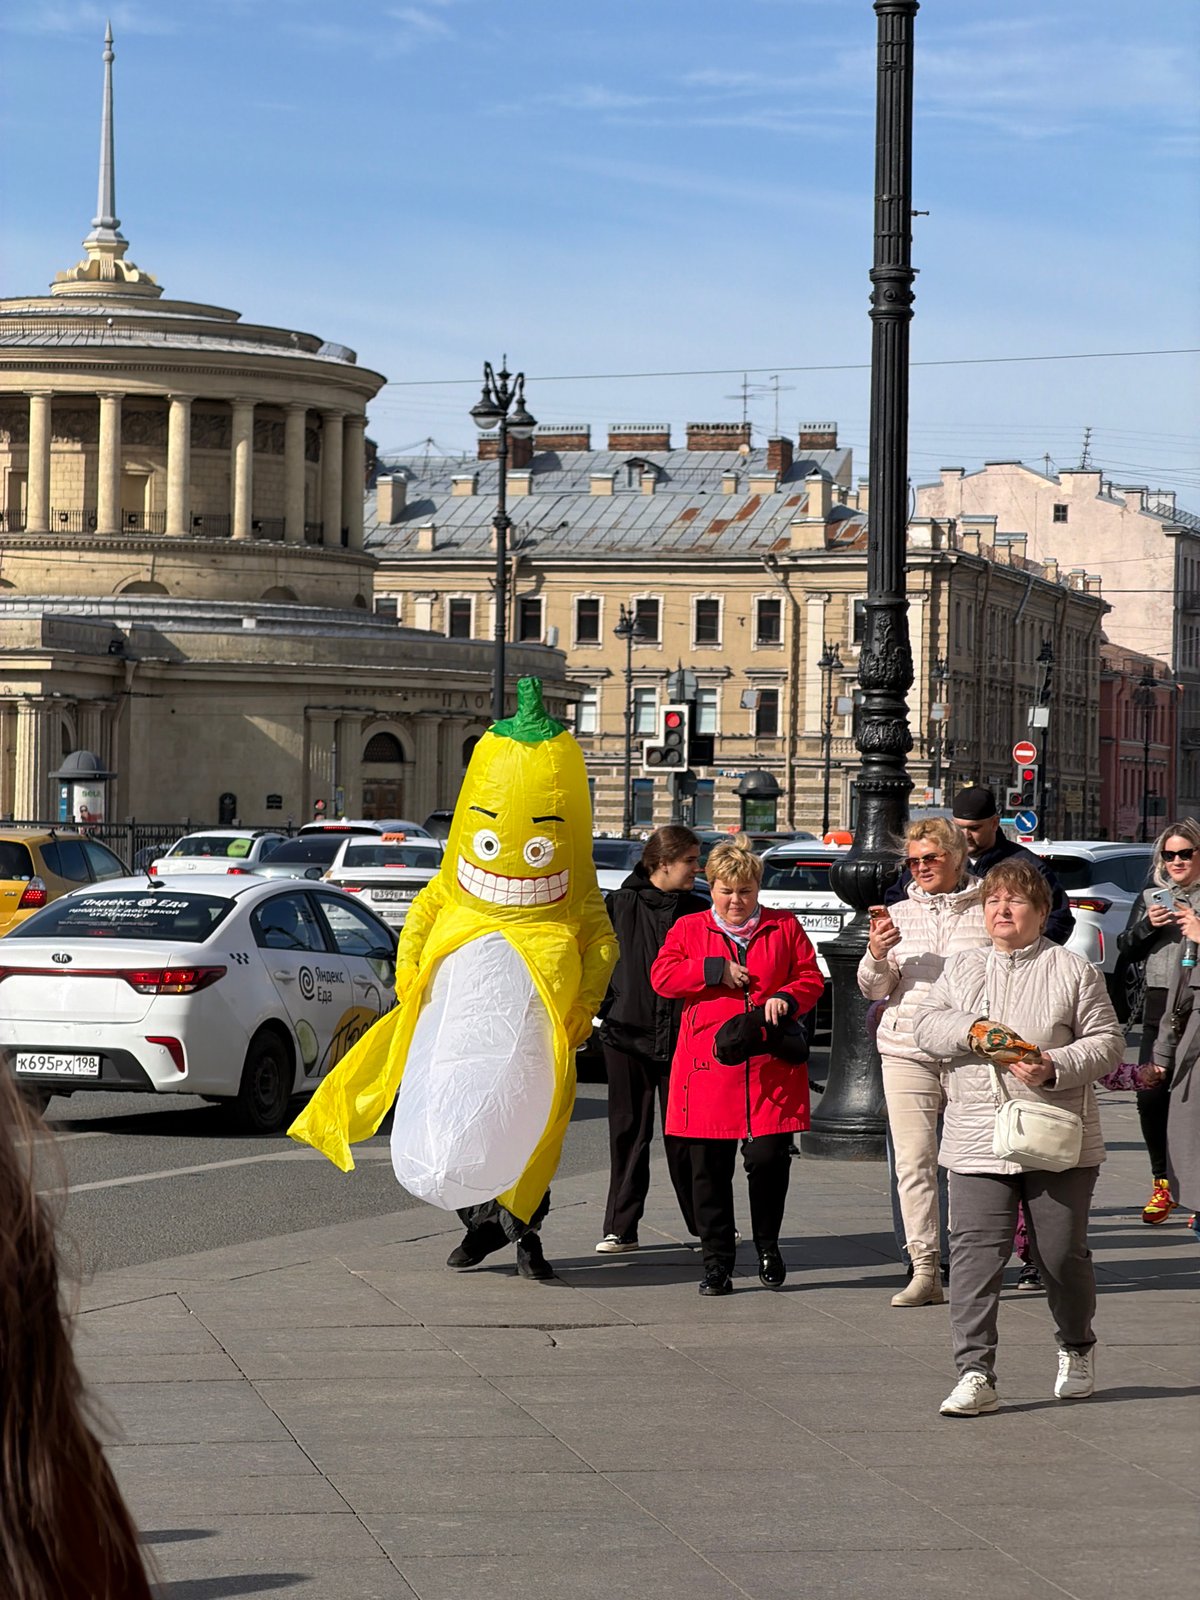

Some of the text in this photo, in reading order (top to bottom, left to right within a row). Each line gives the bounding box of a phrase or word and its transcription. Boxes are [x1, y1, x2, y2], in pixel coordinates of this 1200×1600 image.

[315, 966, 345, 985] Яндекс
[317, 986, 333, 1005] Еда
[19, 1055, 95, 1072] К695РХ 198
